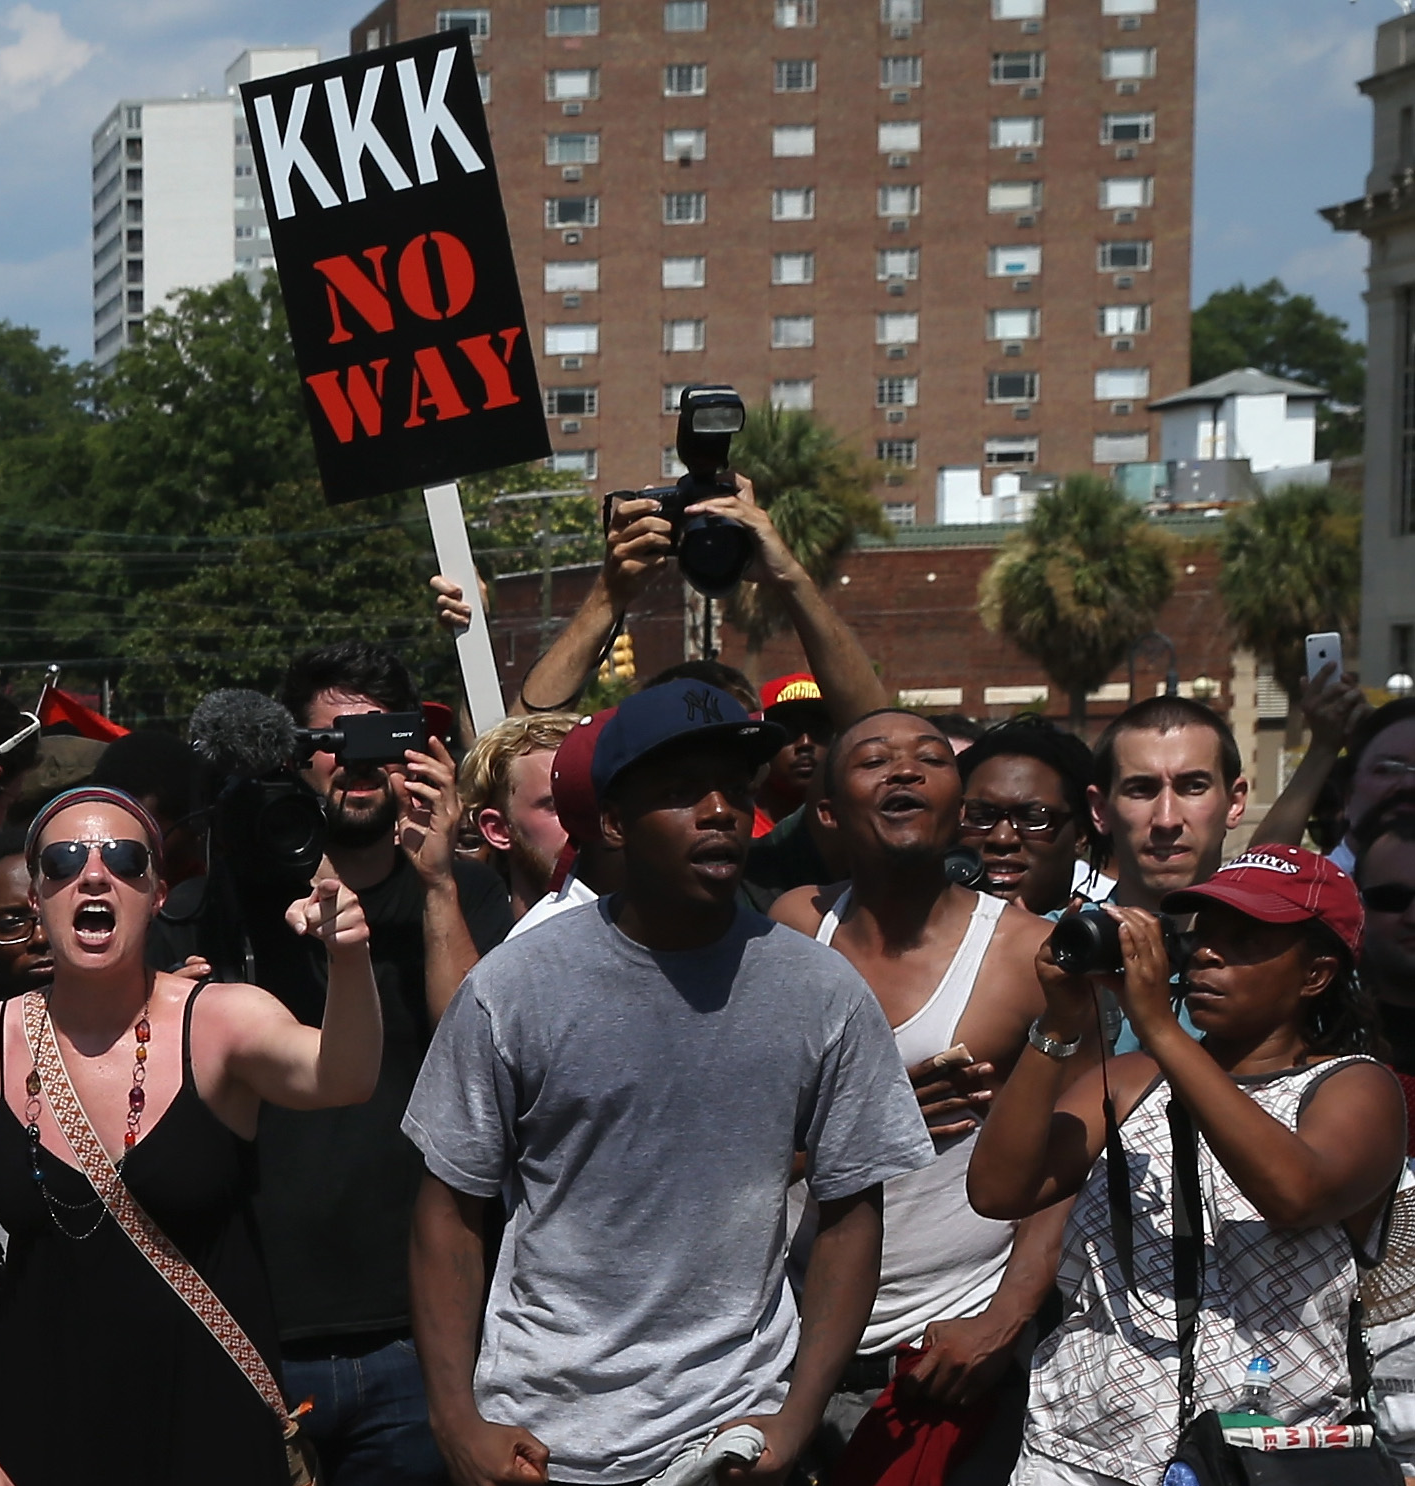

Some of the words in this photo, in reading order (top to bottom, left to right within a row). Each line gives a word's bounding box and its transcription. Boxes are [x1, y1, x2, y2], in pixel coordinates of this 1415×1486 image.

[254, 46, 486, 220] KKK
[314, 231, 476, 345] NO
[306, 327, 522, 444] WAY
